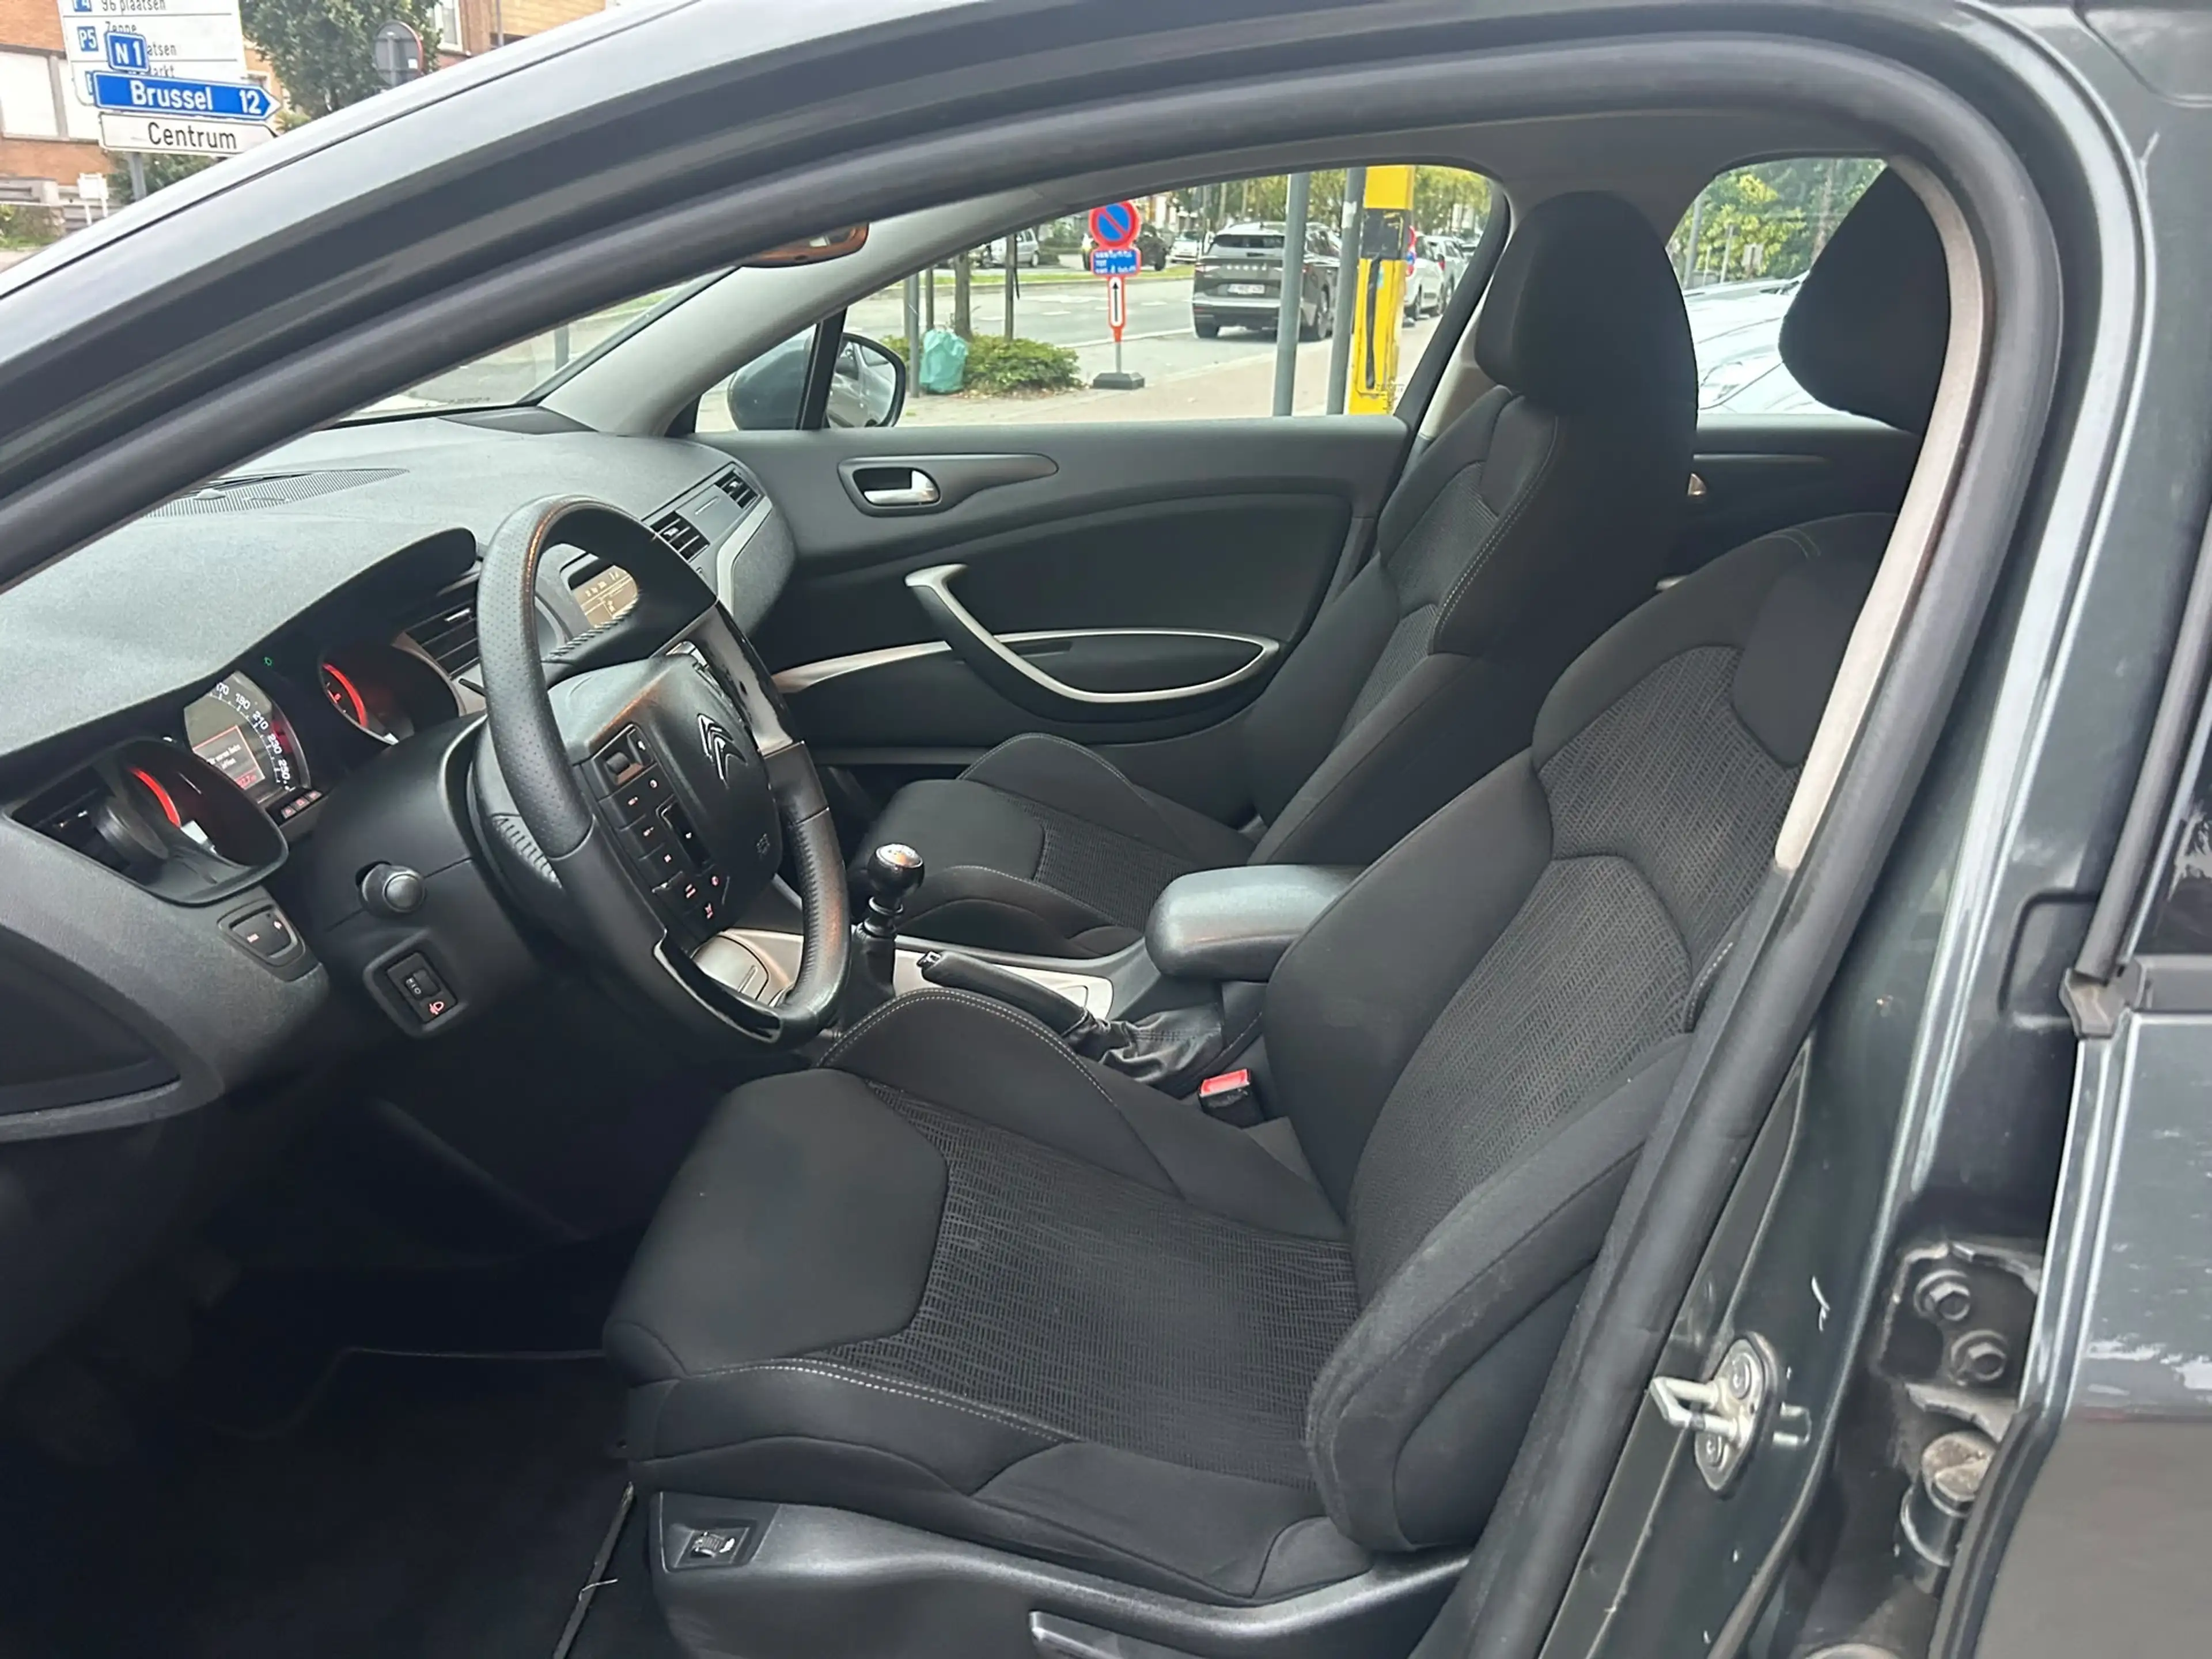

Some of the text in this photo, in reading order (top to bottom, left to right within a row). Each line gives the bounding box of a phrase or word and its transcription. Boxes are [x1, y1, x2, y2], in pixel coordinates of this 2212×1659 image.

[120, 0, 166, 16] plaatsen
[79, 29, 97, 49] P5
[130, 80, 262, 115] Brussel 12
[147, 122, 237, 150] Centrum
[252, 710, 269, 730] 210
[267, 733, 282, 755] 230
